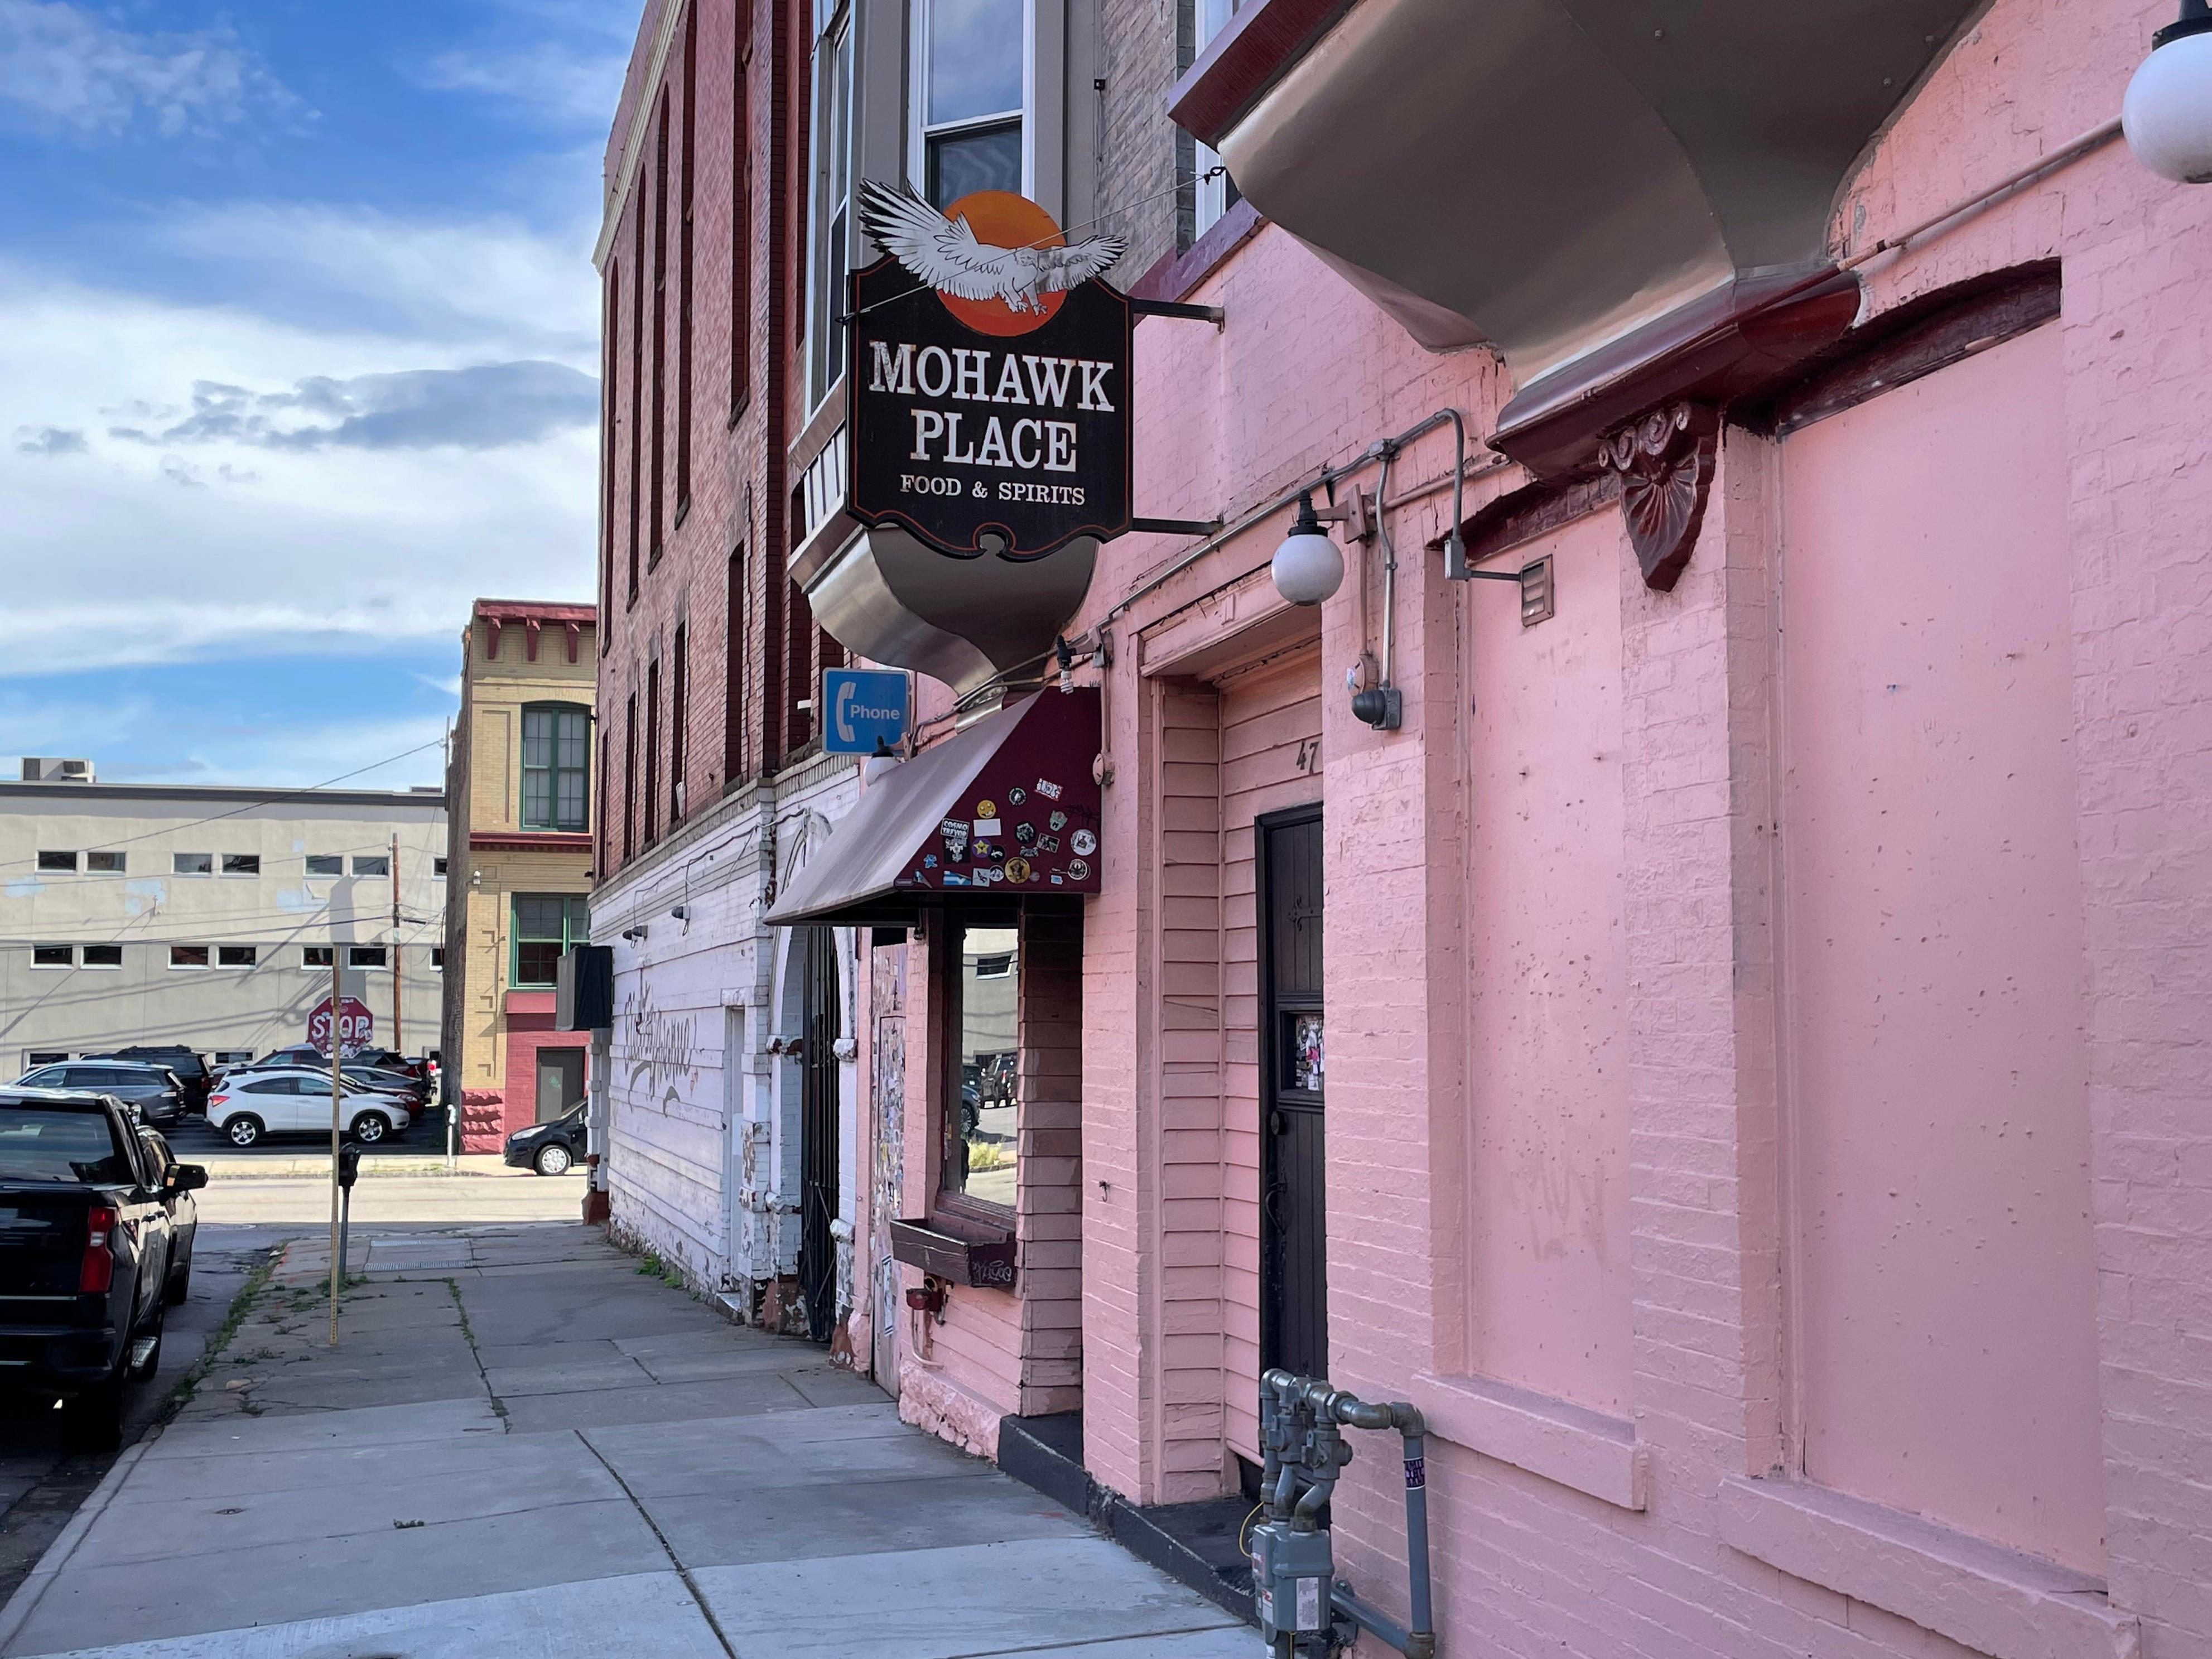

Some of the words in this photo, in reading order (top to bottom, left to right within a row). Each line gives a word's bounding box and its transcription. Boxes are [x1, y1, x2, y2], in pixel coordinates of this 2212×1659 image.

[869, 341, 1115, 412] MOHAWK
[910, 408, 1077, 472] PLACE
[900, 474, 962, 497] FOOD
[972, 481, 988, 499] &
[999, 482, 1085, 505] SPIRITS
[850, 705, 900, 720] Phone
[1296, 739, 1319, 775] 47
[311, 1015, 370, 1039] STOP
